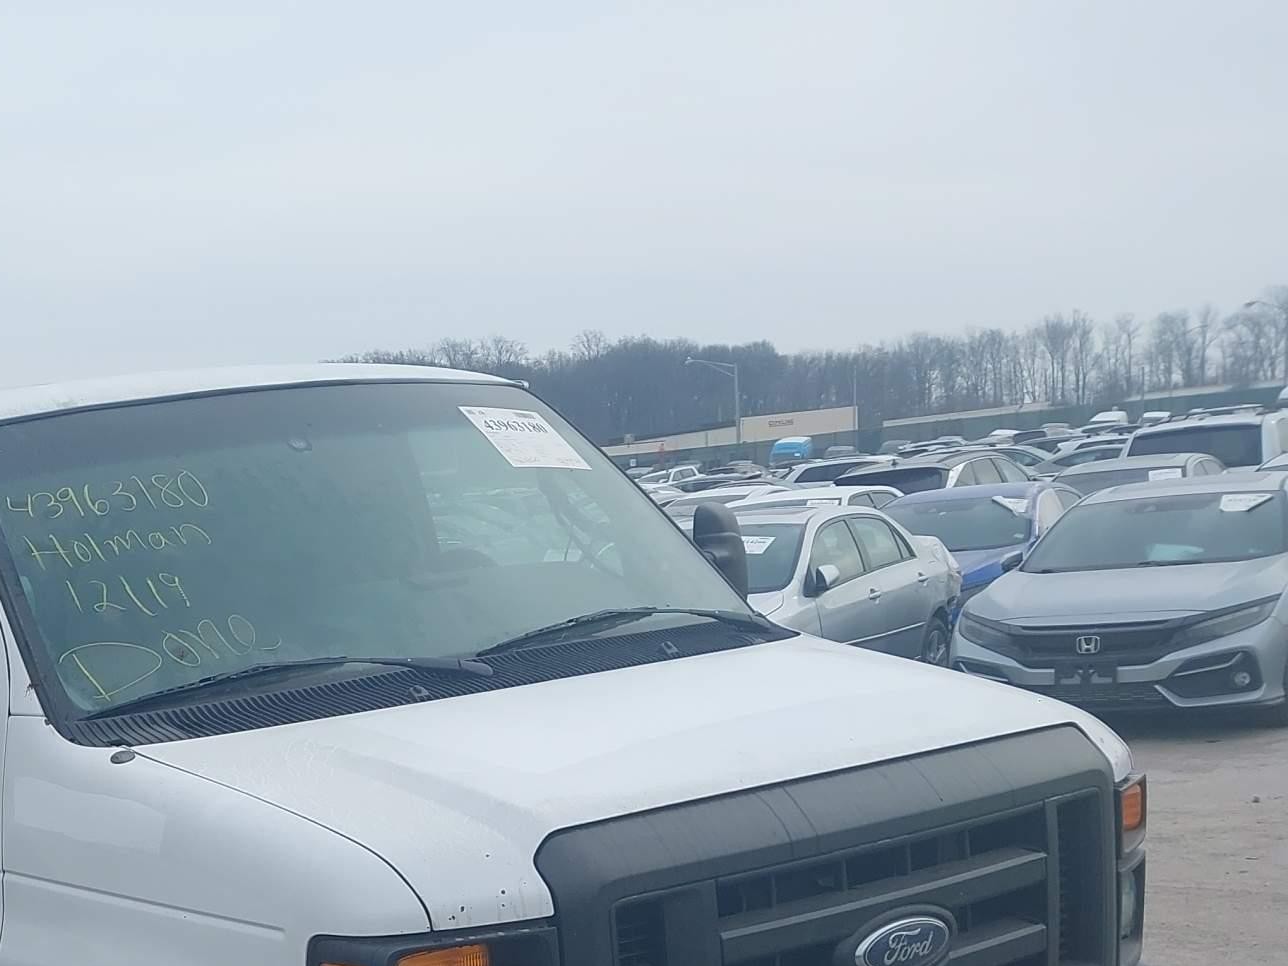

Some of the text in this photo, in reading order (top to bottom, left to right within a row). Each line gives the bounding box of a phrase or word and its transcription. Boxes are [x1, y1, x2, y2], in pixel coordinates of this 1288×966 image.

[483, 419, 548, 433] 43963180
[6, 469, 209, 519] 43963180
[23, 523, 212, 570] Holman
[58, 614, 281, 701] Done
[883, 927, 934, 966] Ford
